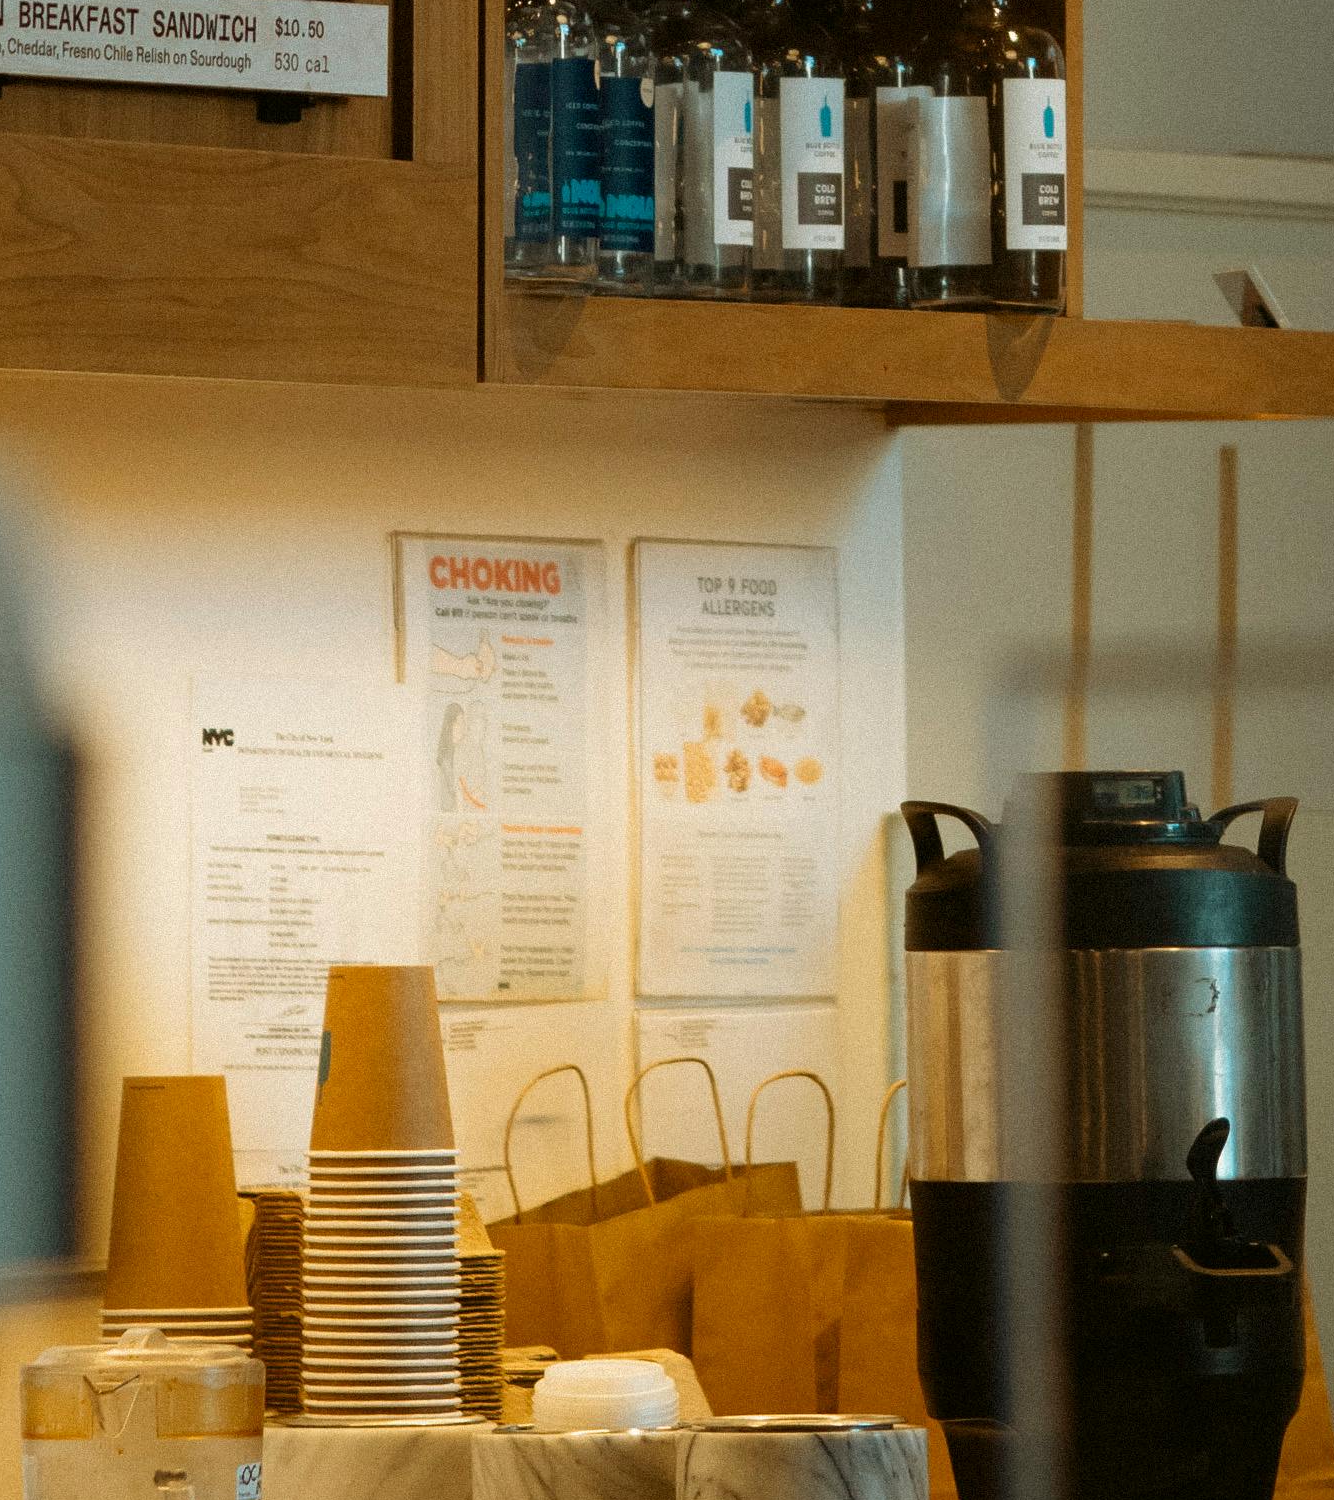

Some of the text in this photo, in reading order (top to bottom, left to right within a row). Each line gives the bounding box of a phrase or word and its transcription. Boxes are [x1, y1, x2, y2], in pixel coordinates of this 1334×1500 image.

[18, 0, 139, 34] BREAKFAST
[152, 10, 257, 42] SANDWICH
[274, 16, 325, 39] $10.50
[6, 37, 59, 59] Cheddar,
[61, 40, 101, 60] Fresno
[102, 43, 133, 62] Chile
[135, 45, 171, 64] Relish
[172, 52, 187, 65] on
[189, 49, 252, 73] Sourdough
[815, 184, 836, 194] COLD
[1038, 184, 1060, 194] COLD
[814, 195, 836, 205] BREW
[1038, 196, 1060, 206] BREW
[428, 555, 563, 596] CHOKING
[696, 576, 723, 593] TOP
[740, 578, 778, 596] FOOD
[700, 599, 776, 618] ALLERGENS
[201, 727, 235, 747] NYC
